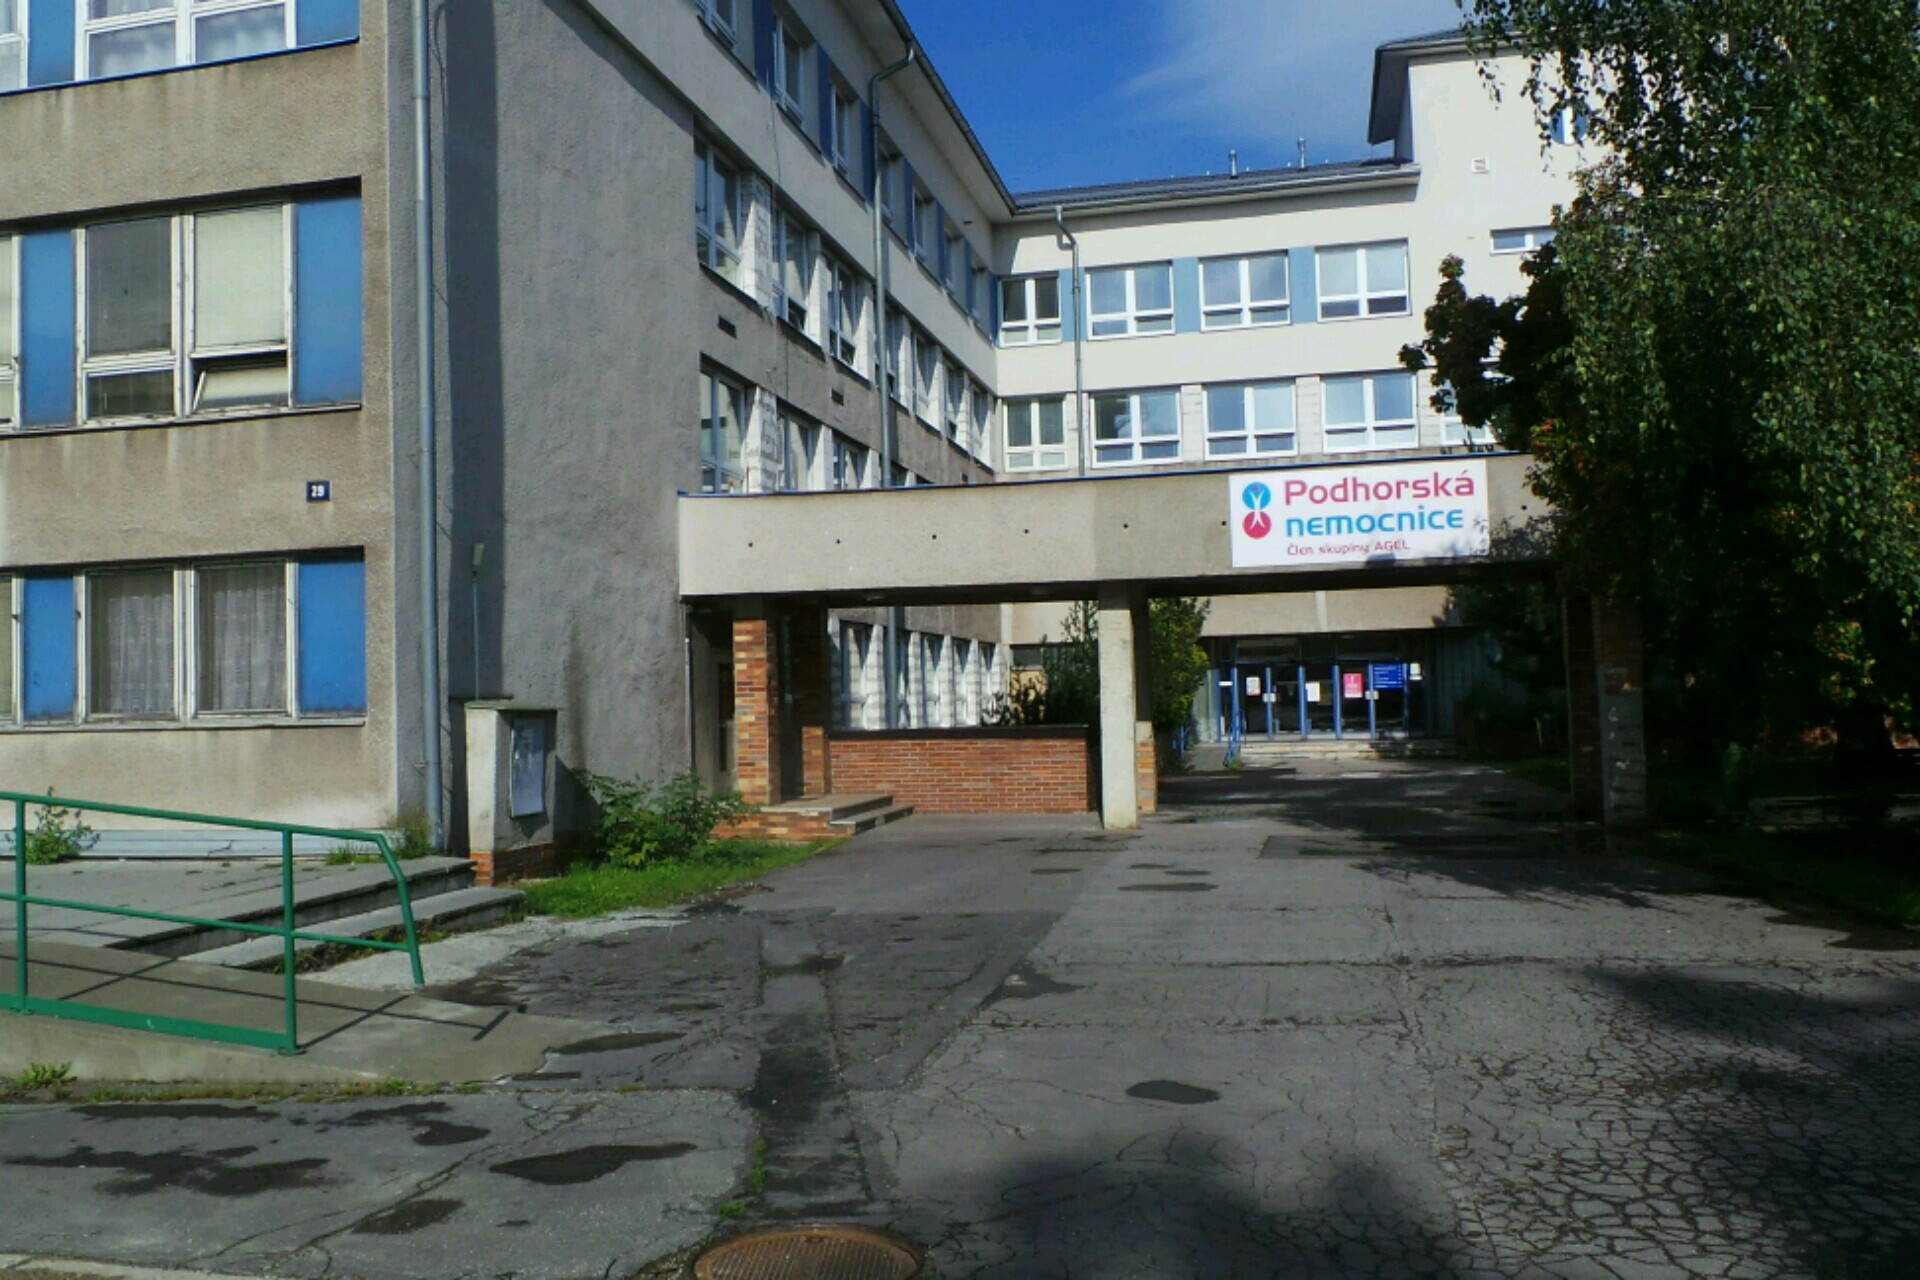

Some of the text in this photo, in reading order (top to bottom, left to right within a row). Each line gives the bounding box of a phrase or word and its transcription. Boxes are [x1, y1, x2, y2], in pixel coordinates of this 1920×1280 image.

[1284, 469, 1475, 506] Podhorská
[1286, 505, 1464, 537] nemocnice
[1287, 543, 1314, 556] Člen
[1374, 540, 1410, 552] AGEL
